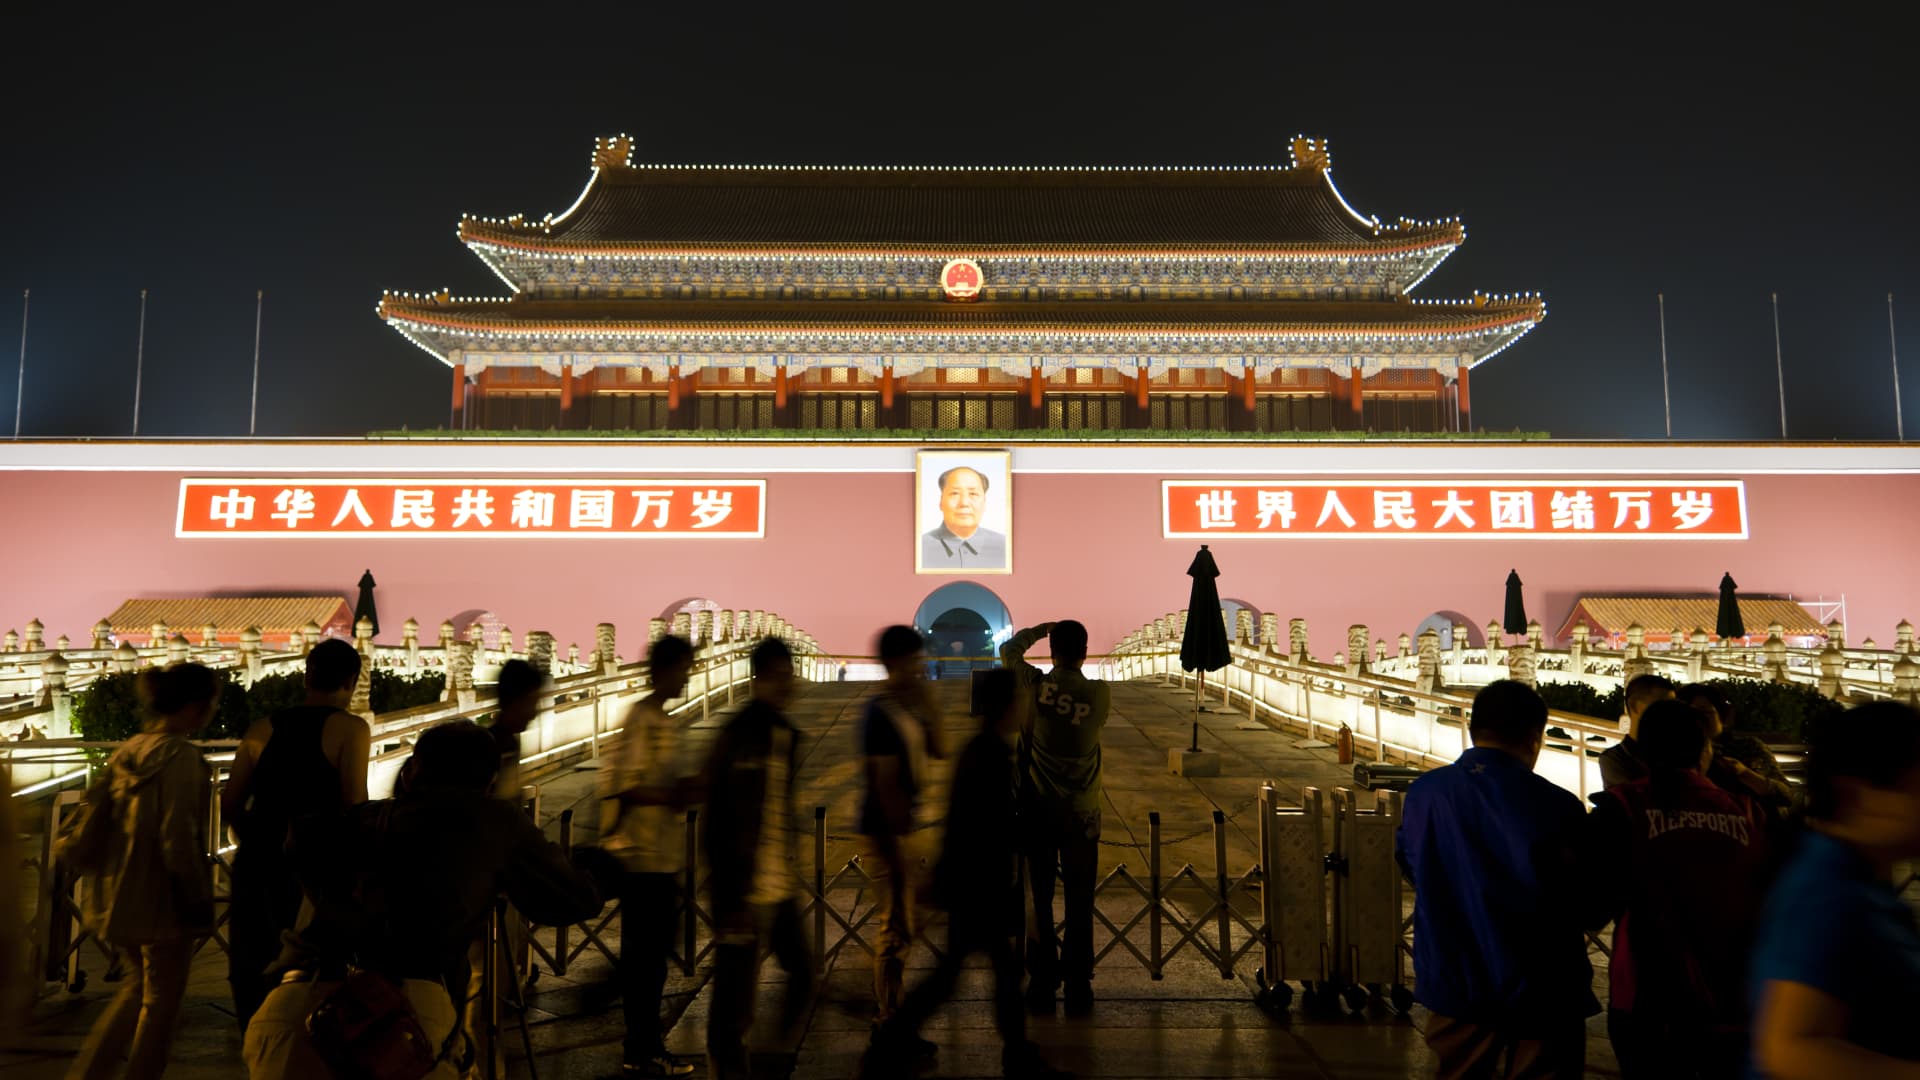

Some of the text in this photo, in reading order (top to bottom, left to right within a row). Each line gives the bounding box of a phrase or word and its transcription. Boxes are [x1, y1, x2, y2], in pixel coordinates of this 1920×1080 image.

[210, 488, 734, 528] 中华人民共和国万岁
[1195, 489, 1714, 530] 世界人民大团结万岁
[1039, 681, 1090, 725] ESP
